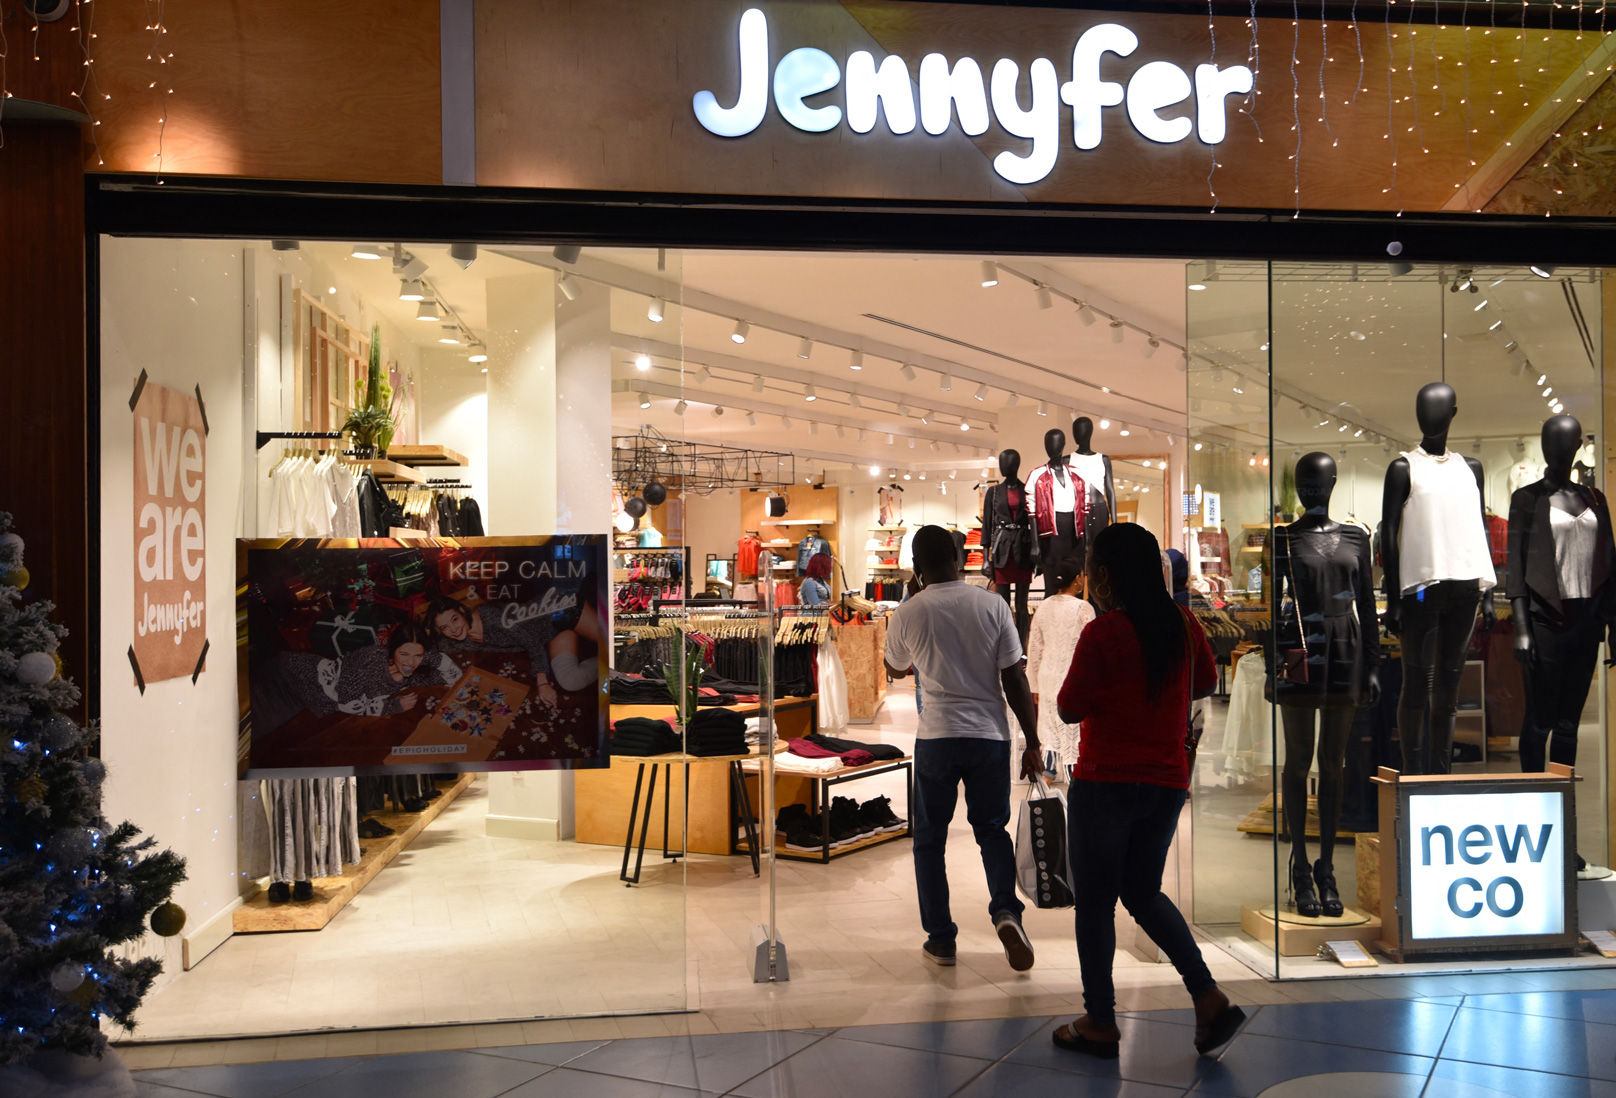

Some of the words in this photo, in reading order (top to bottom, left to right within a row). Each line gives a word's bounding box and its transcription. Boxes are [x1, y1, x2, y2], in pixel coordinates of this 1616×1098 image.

[693, 8, 1253, 184] Jennyfer
[140, 417, 203, 503] we
[138, 502, 204, 582] are
[450, 561, 509, 580] KEEP
[519, 560, 587, 579] CALM
[466, 585, 478, 600] &
[487, 584, 522, 600] EAT
[502, 587, 577, 628] Cookies
[138, 590, 204, 645] Jennyfer
[394, 745, 466, 754] #EPICHOLIDAY
[1421, 823, 1553, 866] new
[1447, 876, 1524, 919] co
